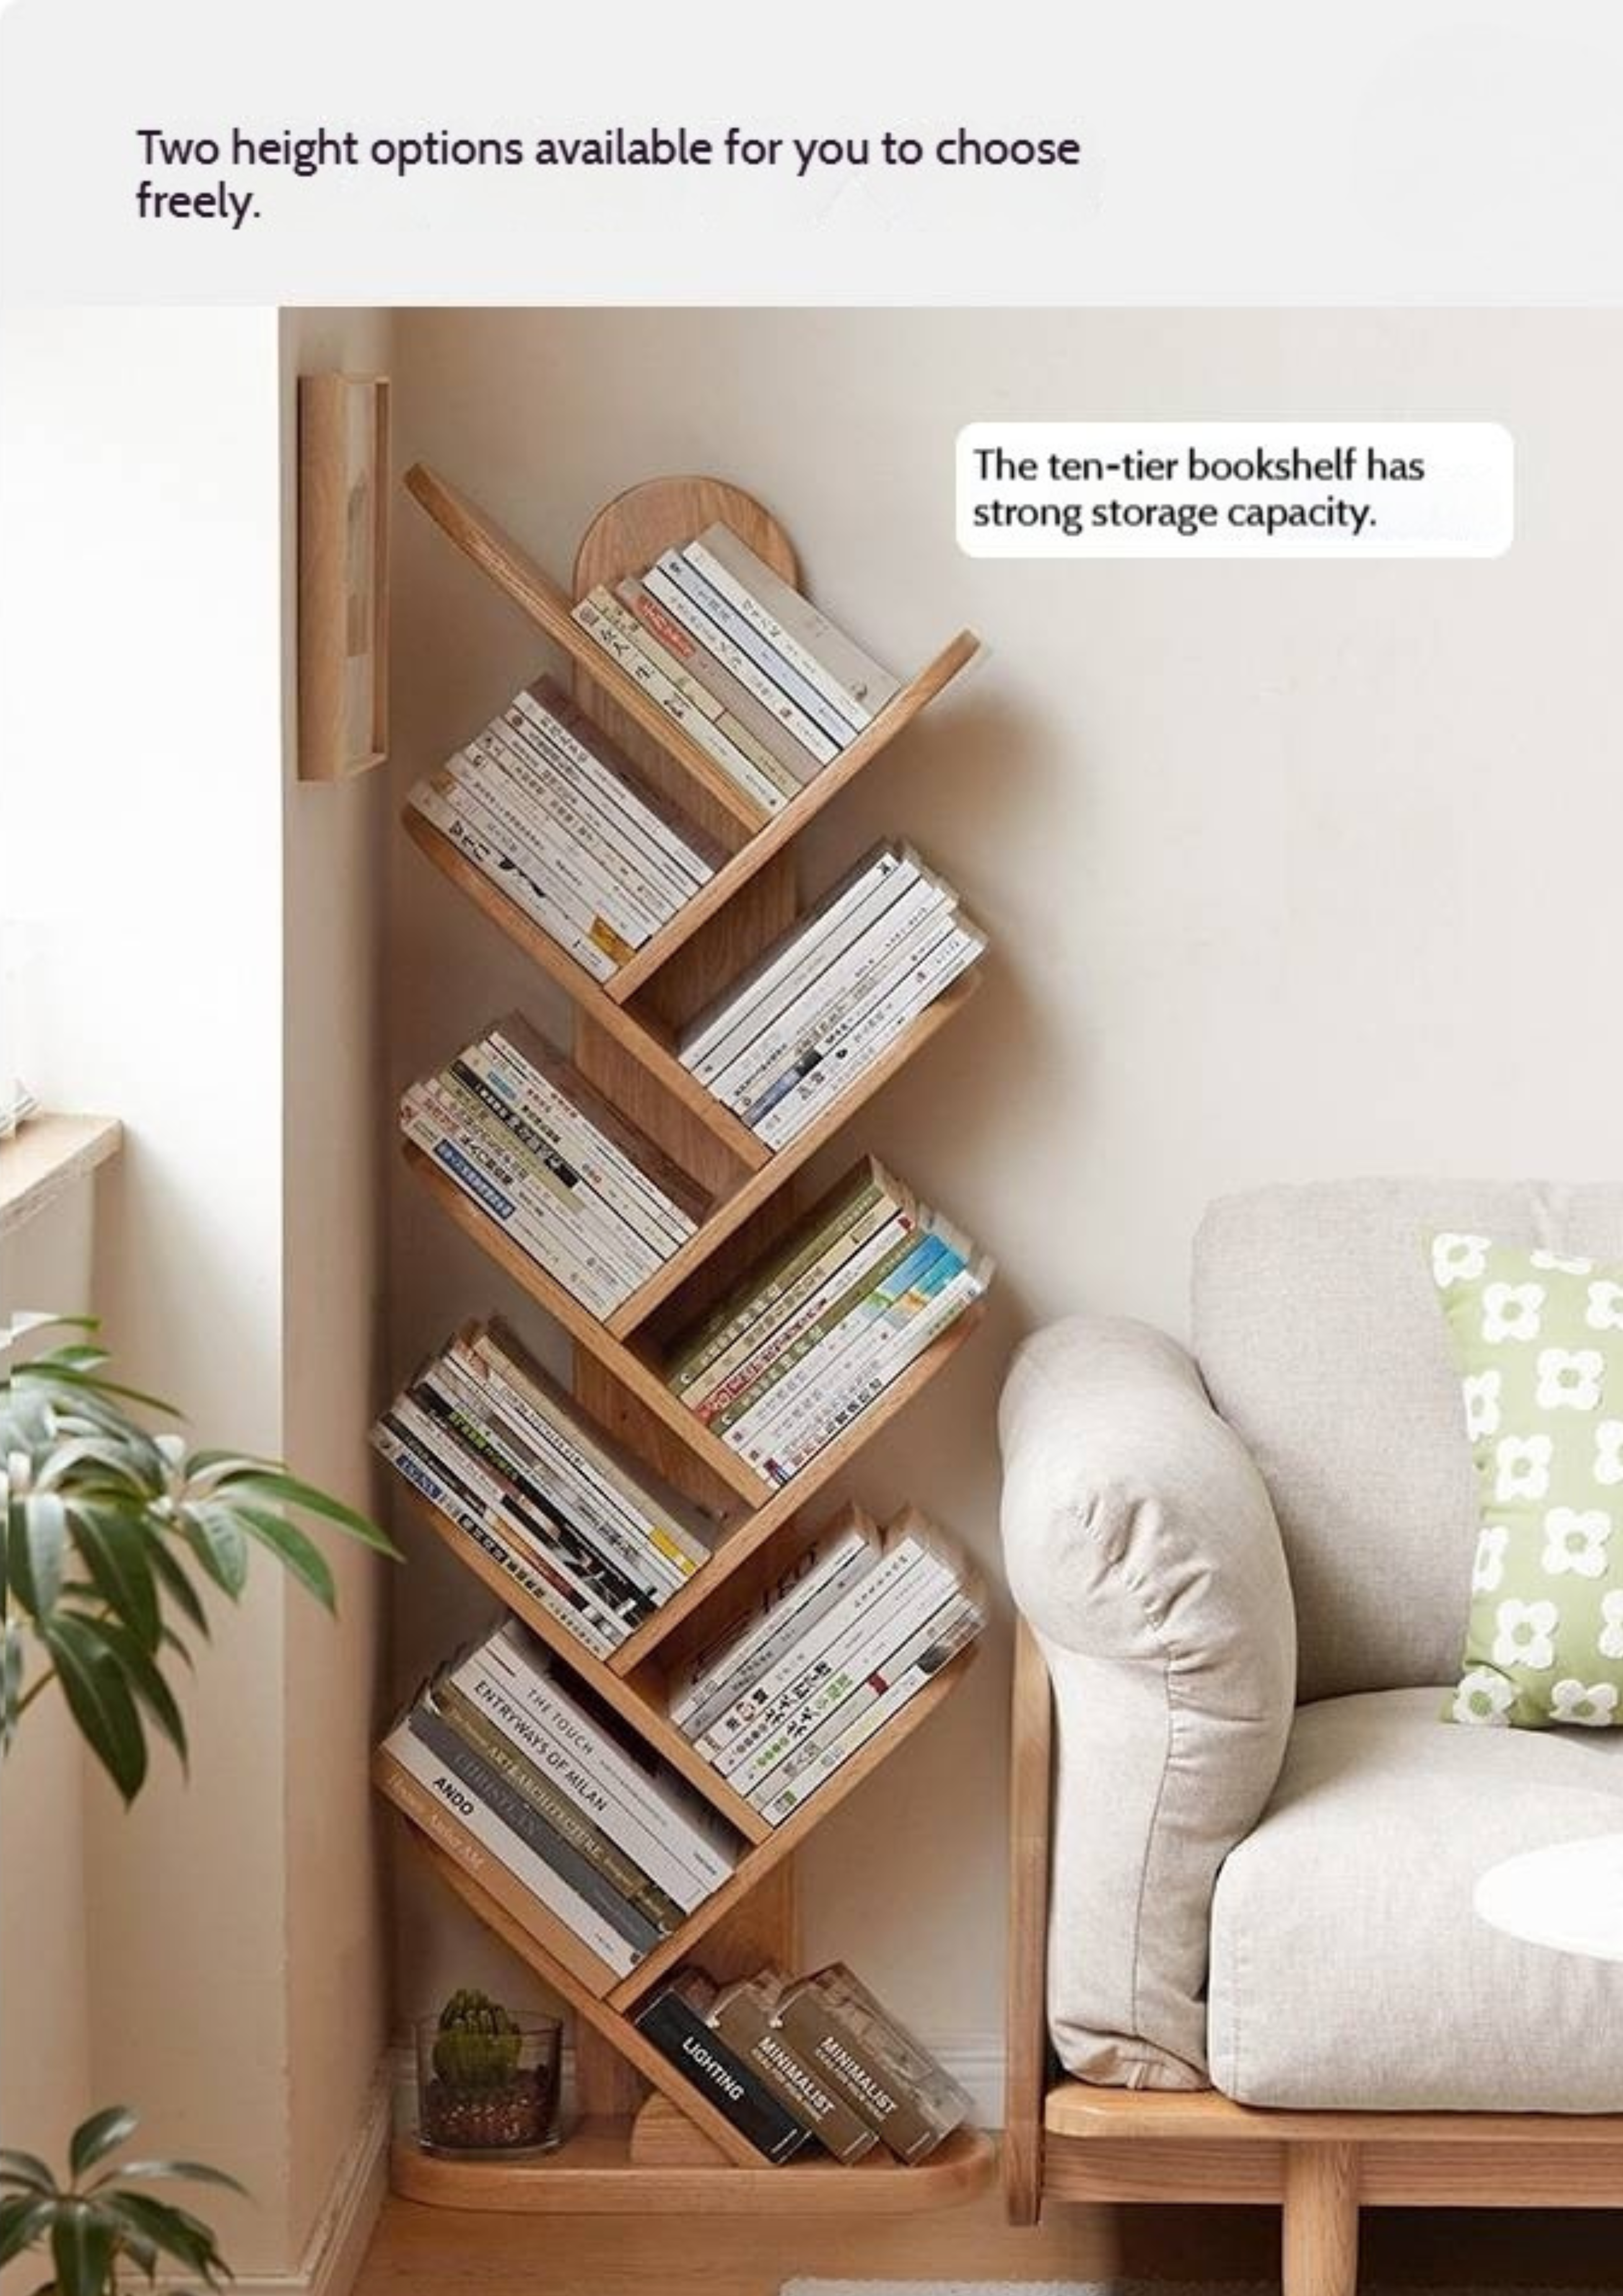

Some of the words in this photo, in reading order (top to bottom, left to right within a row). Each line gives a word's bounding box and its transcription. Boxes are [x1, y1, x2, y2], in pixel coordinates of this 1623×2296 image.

[474, 1680, 549, 1754] ENTRYWAYS
[546, 1751, 568, 1770] OF
[565, 1770, 607, 1812] MILAN
[528, 1689, 552, 1712] THE
[552, 1713, 593, 1755] TOUCH
[433, 1777, 474, 1816] ANDO
[682, 2036, 745, 2101] LIGHTING
[758, 2036, 836, 2115] MINIMALIST
[820, 2036, 898, 2114] MINIMALIST
